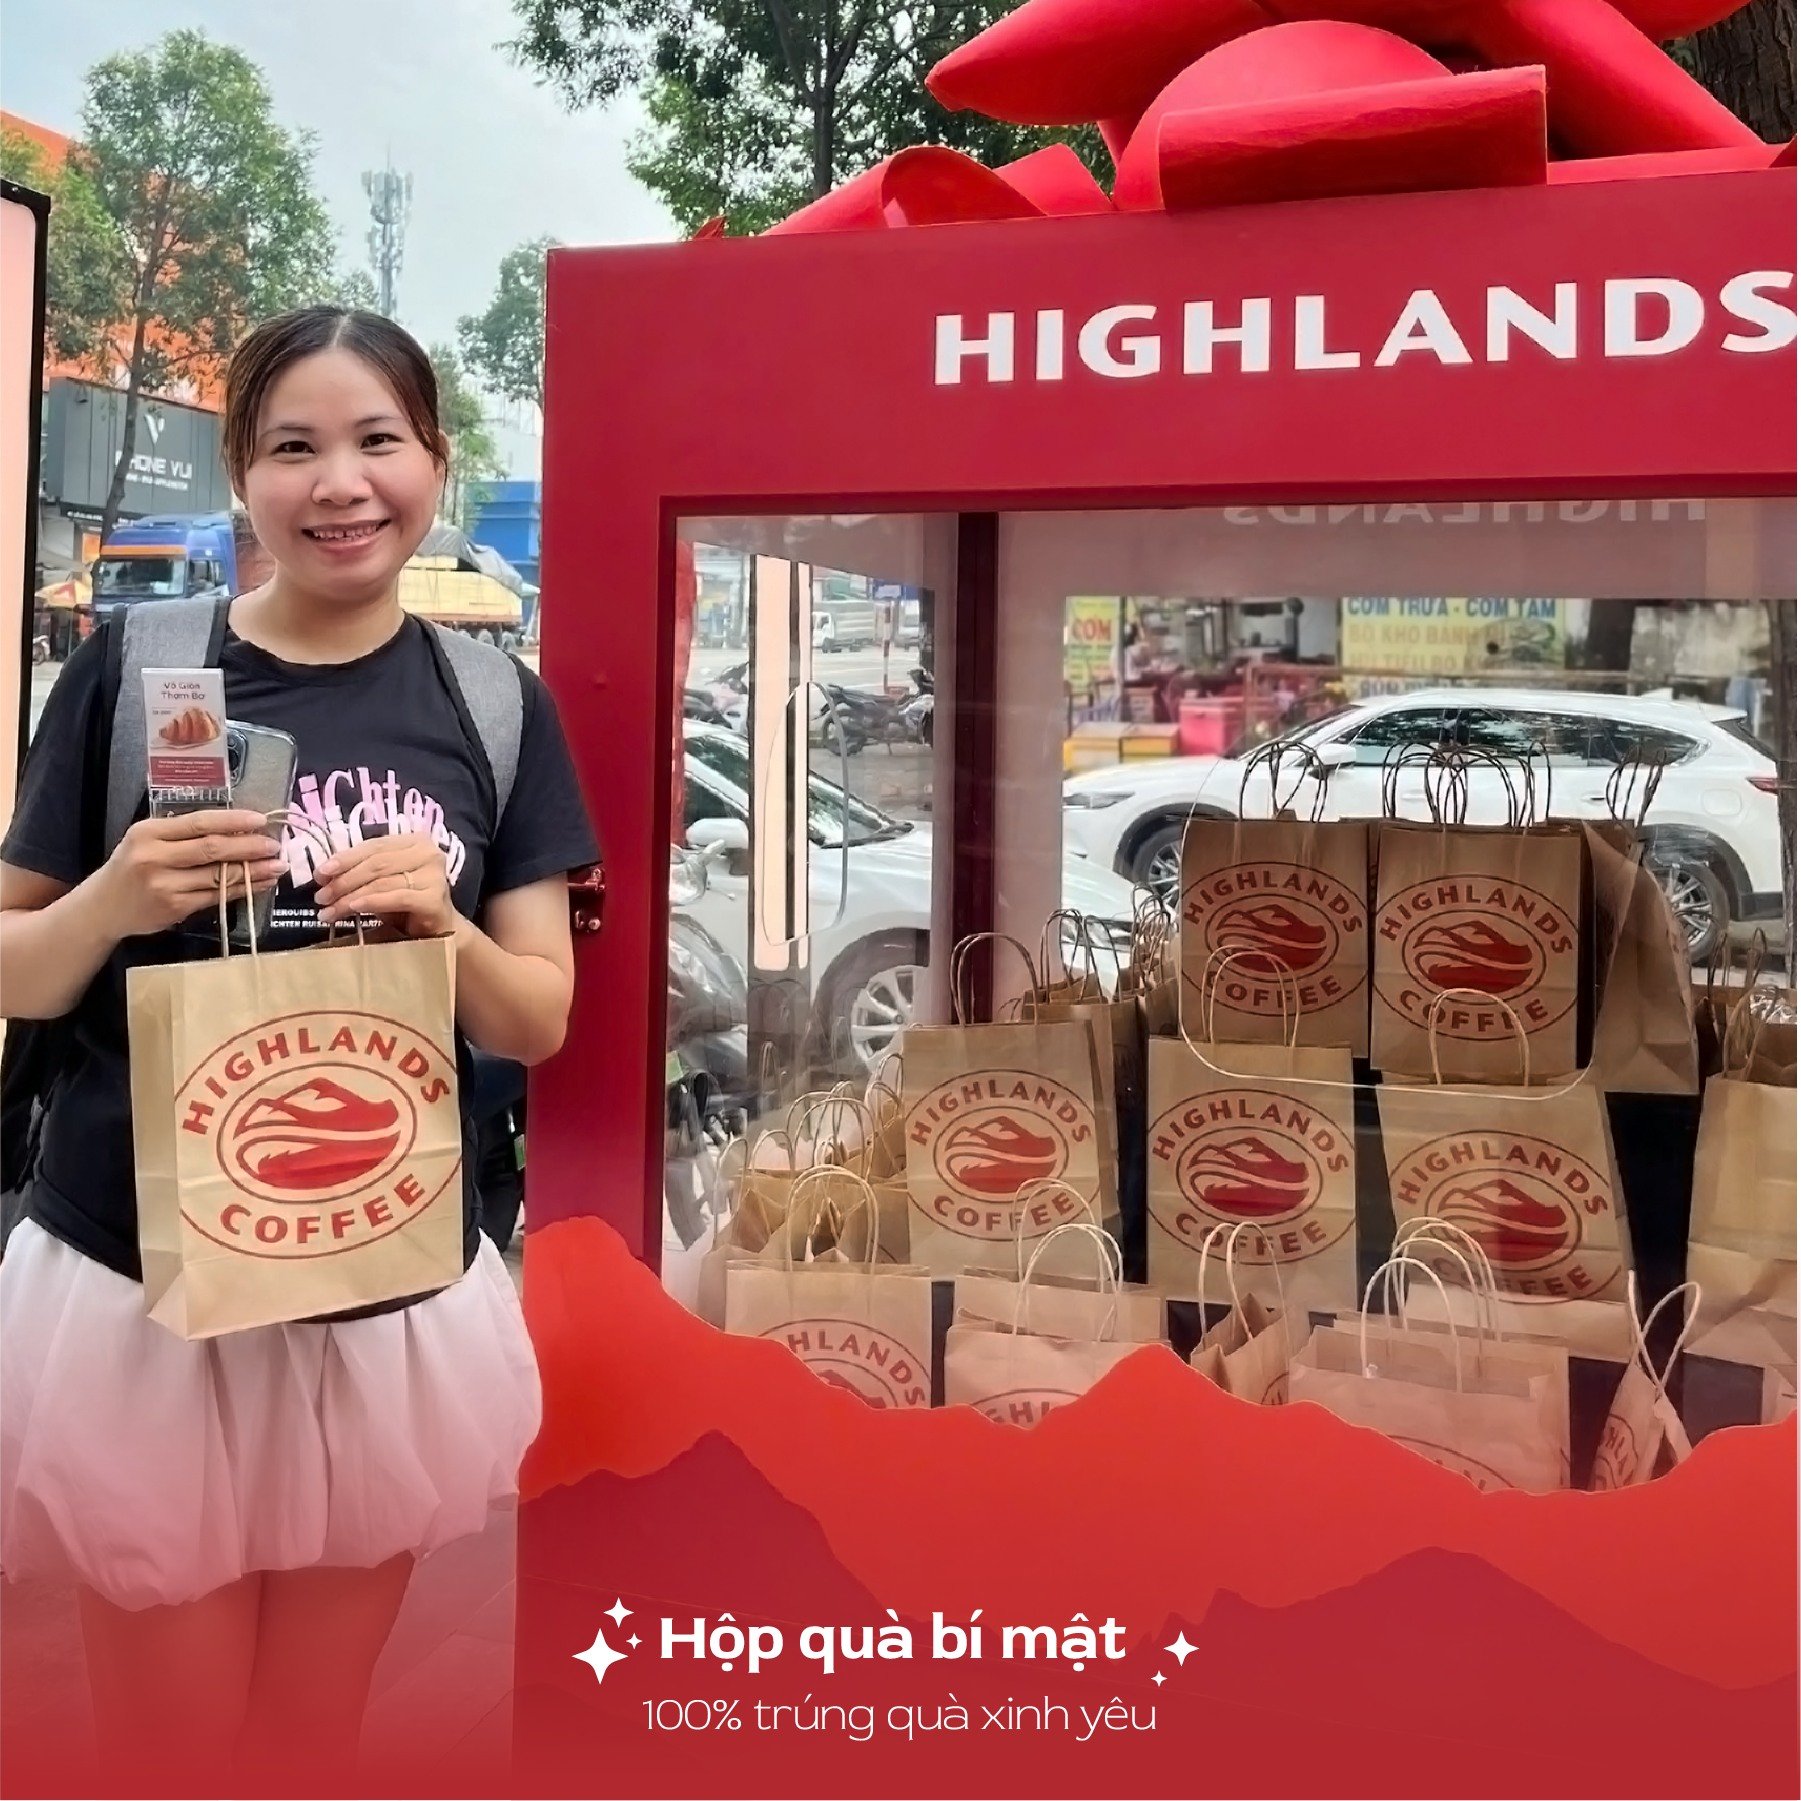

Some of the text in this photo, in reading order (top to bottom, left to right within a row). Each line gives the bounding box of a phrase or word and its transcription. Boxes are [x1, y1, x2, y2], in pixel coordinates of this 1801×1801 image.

[935, 271, 1797, 384] HIGHLANDS
[1182, 870, 1363, 935] HIGHLANDS
[1378, 884, 1573, 955] HIGHLANDS
[182, 1026, 450, 1135] HIGHLANDS
[910, 1078, 1092, 1147] HIGHLANDS
[1152, 1099, 1349, 1173] HIGHLANDS
[220, 1173, 426, 1244] COFFEE
[934, 1192, 1075, 1232] COFFEE
[1397, 1141, 1609, 1216] HIGHLANDS
